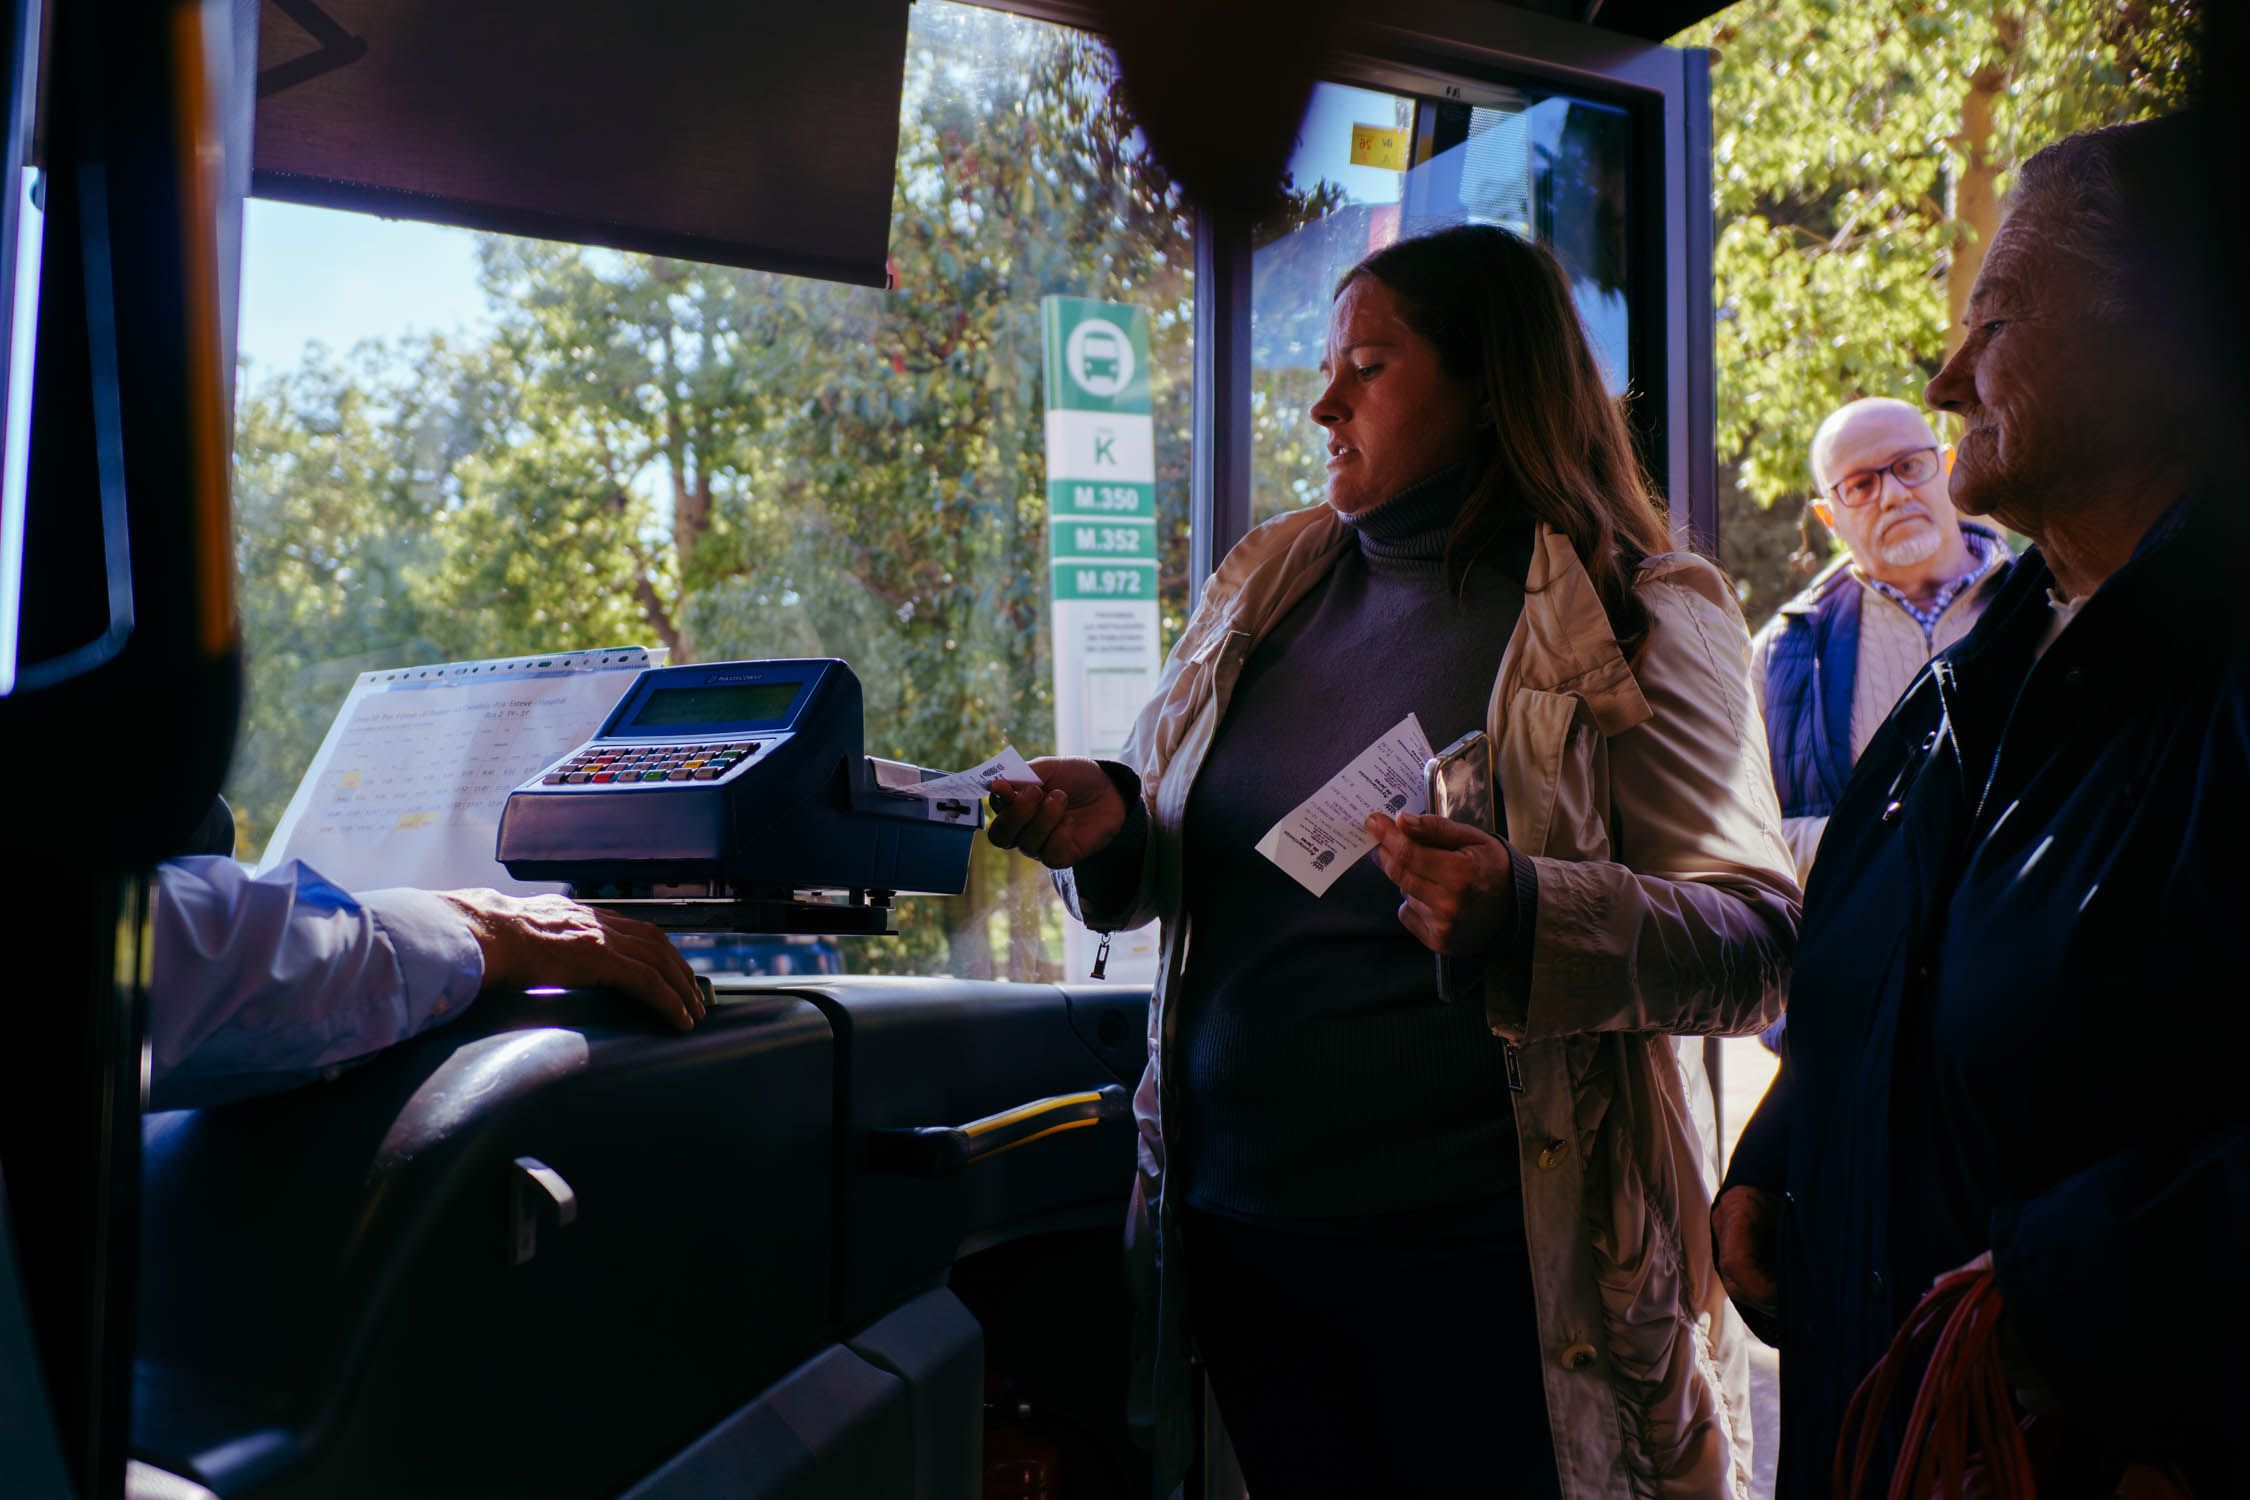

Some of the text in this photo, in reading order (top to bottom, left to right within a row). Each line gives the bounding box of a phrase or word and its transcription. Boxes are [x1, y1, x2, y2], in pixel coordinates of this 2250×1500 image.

[1094, 436, 1117, 465] K
[1074, 486, 1139, 511] M.350
[1075, 527, 1140, 552] M.352
[1076, 569, 1141, 594] M.972
